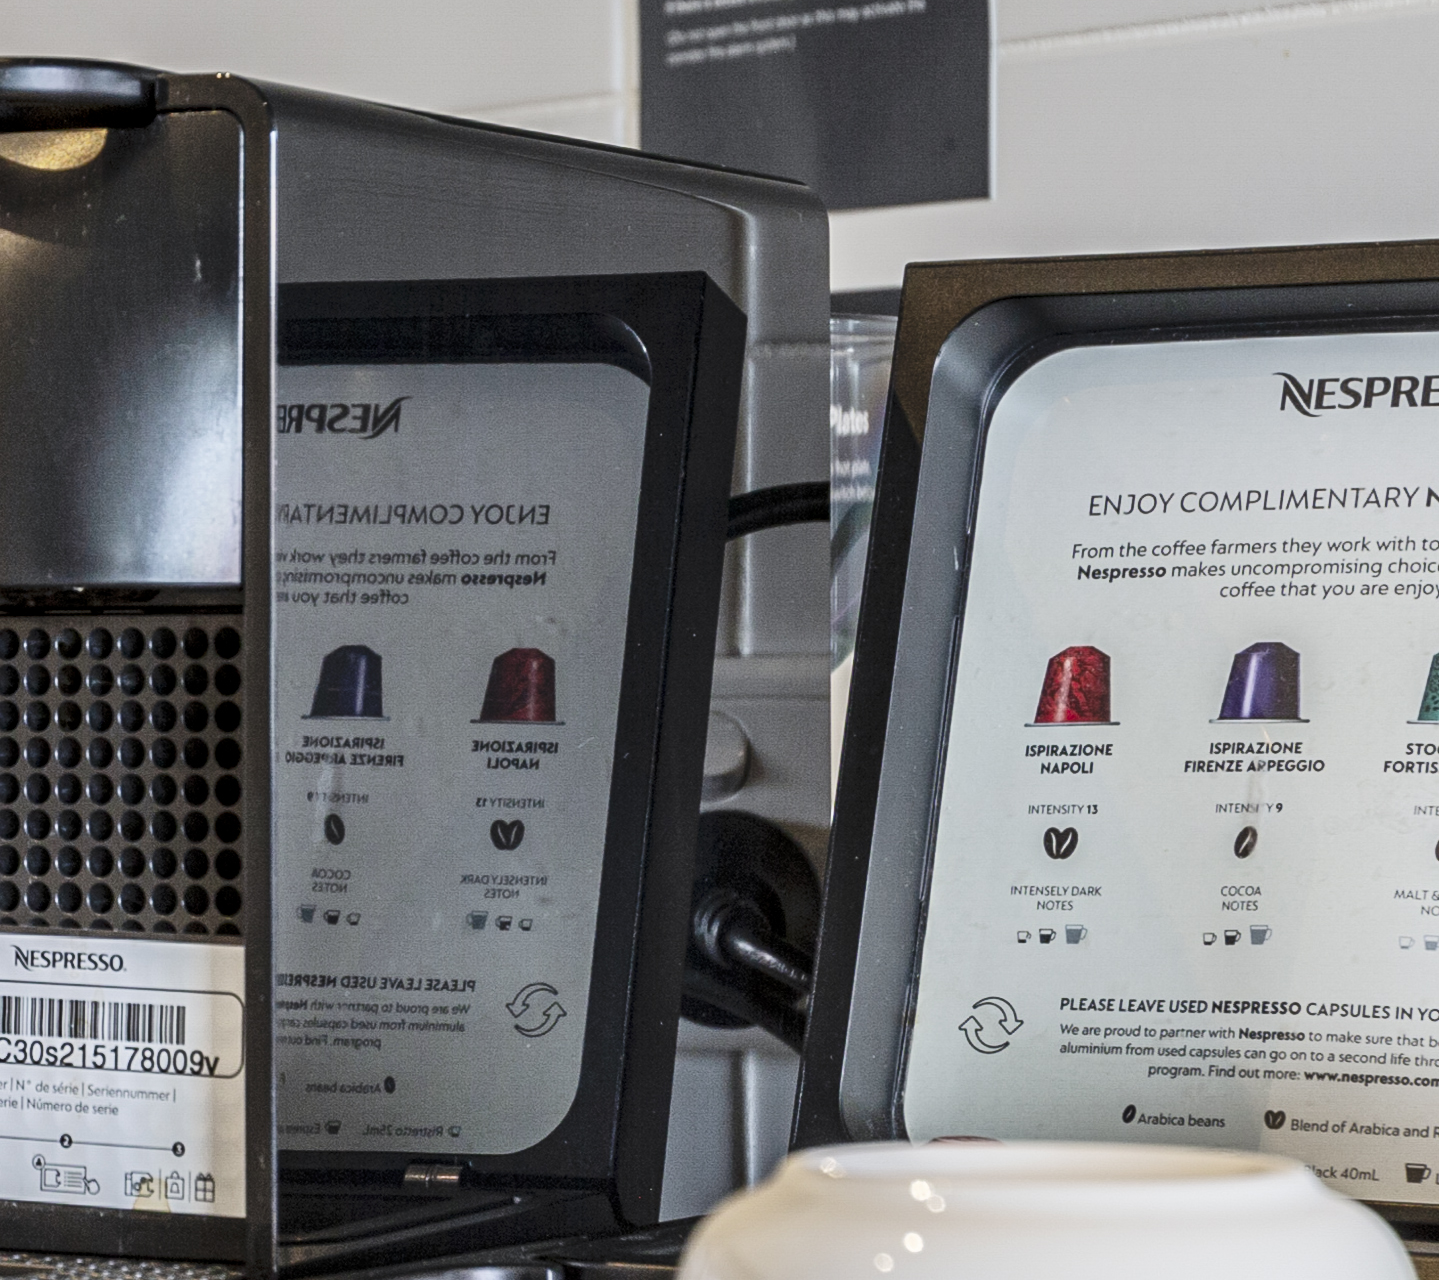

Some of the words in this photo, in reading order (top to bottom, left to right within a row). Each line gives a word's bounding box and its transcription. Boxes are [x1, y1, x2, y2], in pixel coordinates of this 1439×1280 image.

[1089, 492, 1174, 516] ENJOY
[1180, 486, 1419, 513] COMPLIMENTARY
[1072, 543, 1114, 559] From
[1119, 542, 1147, 557] the
[1151, 539, 1206, 556] coffee
[1211, 539, 1276, 554] farmers
[1282, 538, 1322, 556] they
[1327, 537, 1370, 554] work
[1376, 536, 1415, 553] with
[1422, 538, 1439, 554] to
[1077, 564, 1166, 583] Nespresso
[1171, 562, 1225, 577] makes
[1231, 562, 1382, 580] uncompromising
[1219, 581, 1275, 597] coffee
[1280, 581, 1316, 596] that
[1322, 584, 1354, 599] you
[1360, 583, 1388, 595] are
[1025, 743, 1113, 757] ISPIRAZIONE
[1209, 741, 1303, 754] ISPIRAZIONE
[1040, 761, 1093, 774] NAPOLI
[1184, 759, 1243, 772] FIRENZE
[1246, 759, 1325, 772] ARPEGGIO
[1028, 804, 1084, 815] INTENSITY
[1086, 804, 1098, 815] 13
[1275, 802, 1284, 814] 9
[1010, 885, 1069, 896] INTENSELY
[1071, 885, 1101, 896] DARK
[1220, 885, 1261, 896] COCOA
[1393, 889, 1428, 900] MALT
[1431, 890, 1439, 901] &
[1036, 899, 1073, 910] NOTES
[1221, 900, 1258, 911] NOTES
[10, 944, 124, 972] NESPRESSO
[1059, 997, 1115, 1011] PLEASE
[1118, 998, 1165, 1012] LEAVE
[1169, 999, 1208, 1013] USED
[1211, 1000, 1301, 1015] NESPRESSO
[1306, 1002, 1390, 1019] CAPSULES
[1395, 1006, 1413, 1019] IN
[1060, 1023, 1079, 1035] We
[1081, 1026, 1101, 1036] are
[1103, 1024, 1141, 1039] proud
[1144, 1027, 1156, 1037] to
[1159, 1028, 1206, 1040] partner
[1208, 1026, 1235, 1039] with
[1238, 1027, 1305, 1043] Nespresso
[1308, 1031, 1322, 1042] to
[1326, 1031, 1361, 1044] make
[1365, 1035, 1392, 1045] sure
[1397, 1034, 1424, 1047] that
[1059, 1041, 1122, 1055] aluminium
[1125, 1042, 1154, 1055] from
[1157, 1044, 1186, 1057] used
[1188, 1046, 1241, 1060] capsules
[1243, 1049, 1266, 1059] can
[1269, 1050, 1286, 1063] go
[1289, 1051, 1306, 1060] on
[1310, 1051, 1324, 1061] to
[1327, 1052, 1335, 1062] a
[1338, 1052, 1386, 1064] second
[1390, 1052, 1411, 1066] life
[1147, 1065, 1204, 1079] program.
[1208, 1064, 1235, 1077] Find
[1238, 1068, 1259, 1079] out
[1263, 1069, 1300, 1080] more:
[35, 1080, 49, 1093] de
[52, 1082, 79, 1095] série
[87, 1084, 170, 1101] Seriennummer
[26, 1097, 72, 1112] Número
[74, 1101, 89, 1113] de
[92, 1105, 118, 1115] serie
[1137, 1112, 1185, 1126] Arabica
[1187, 1113, 1225, 1128] beans
[1290, 1118, 1329, 1132] Blend
[1331, 1120, 1347, 1133] of
[1348, 1122, 1400, 1136] Arabica
[1402, 1125, 1429, 1138] and
